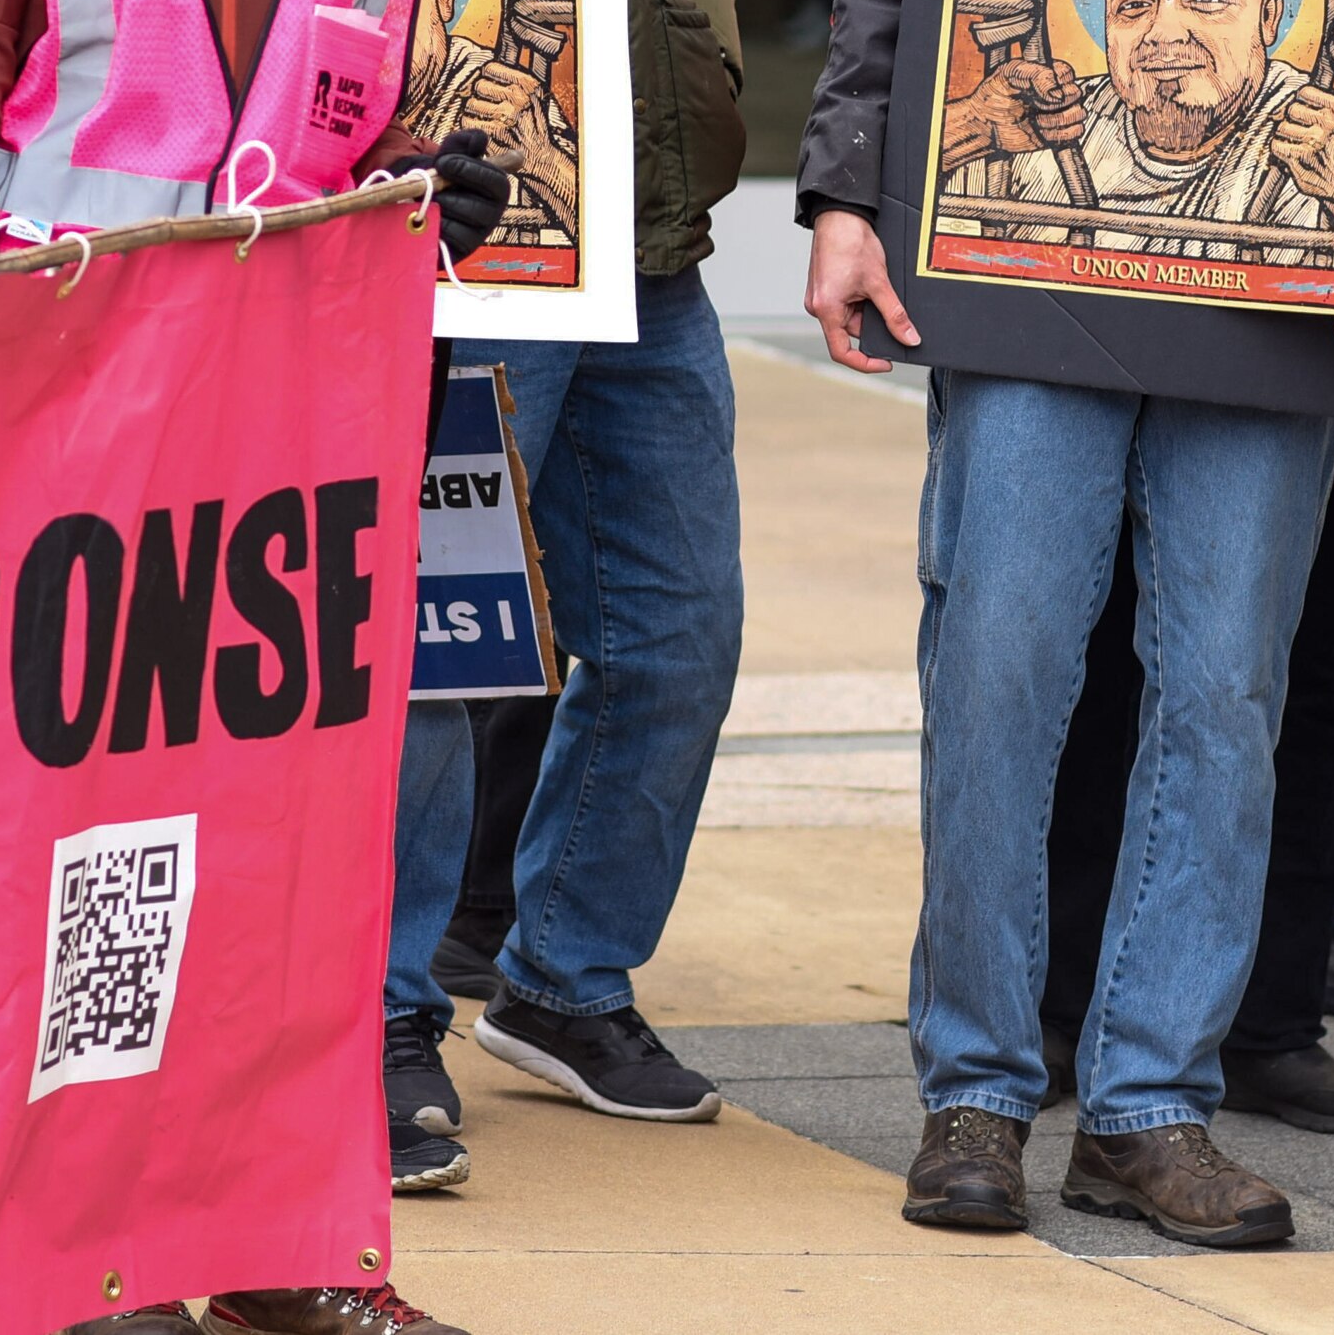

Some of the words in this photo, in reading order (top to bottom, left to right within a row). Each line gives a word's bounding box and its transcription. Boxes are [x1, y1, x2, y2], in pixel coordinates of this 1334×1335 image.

[1072, 255, 1151, 282] UNION
[1155, 264, 1251, 292] MEMBER
[496, 600, 516, 641] I
